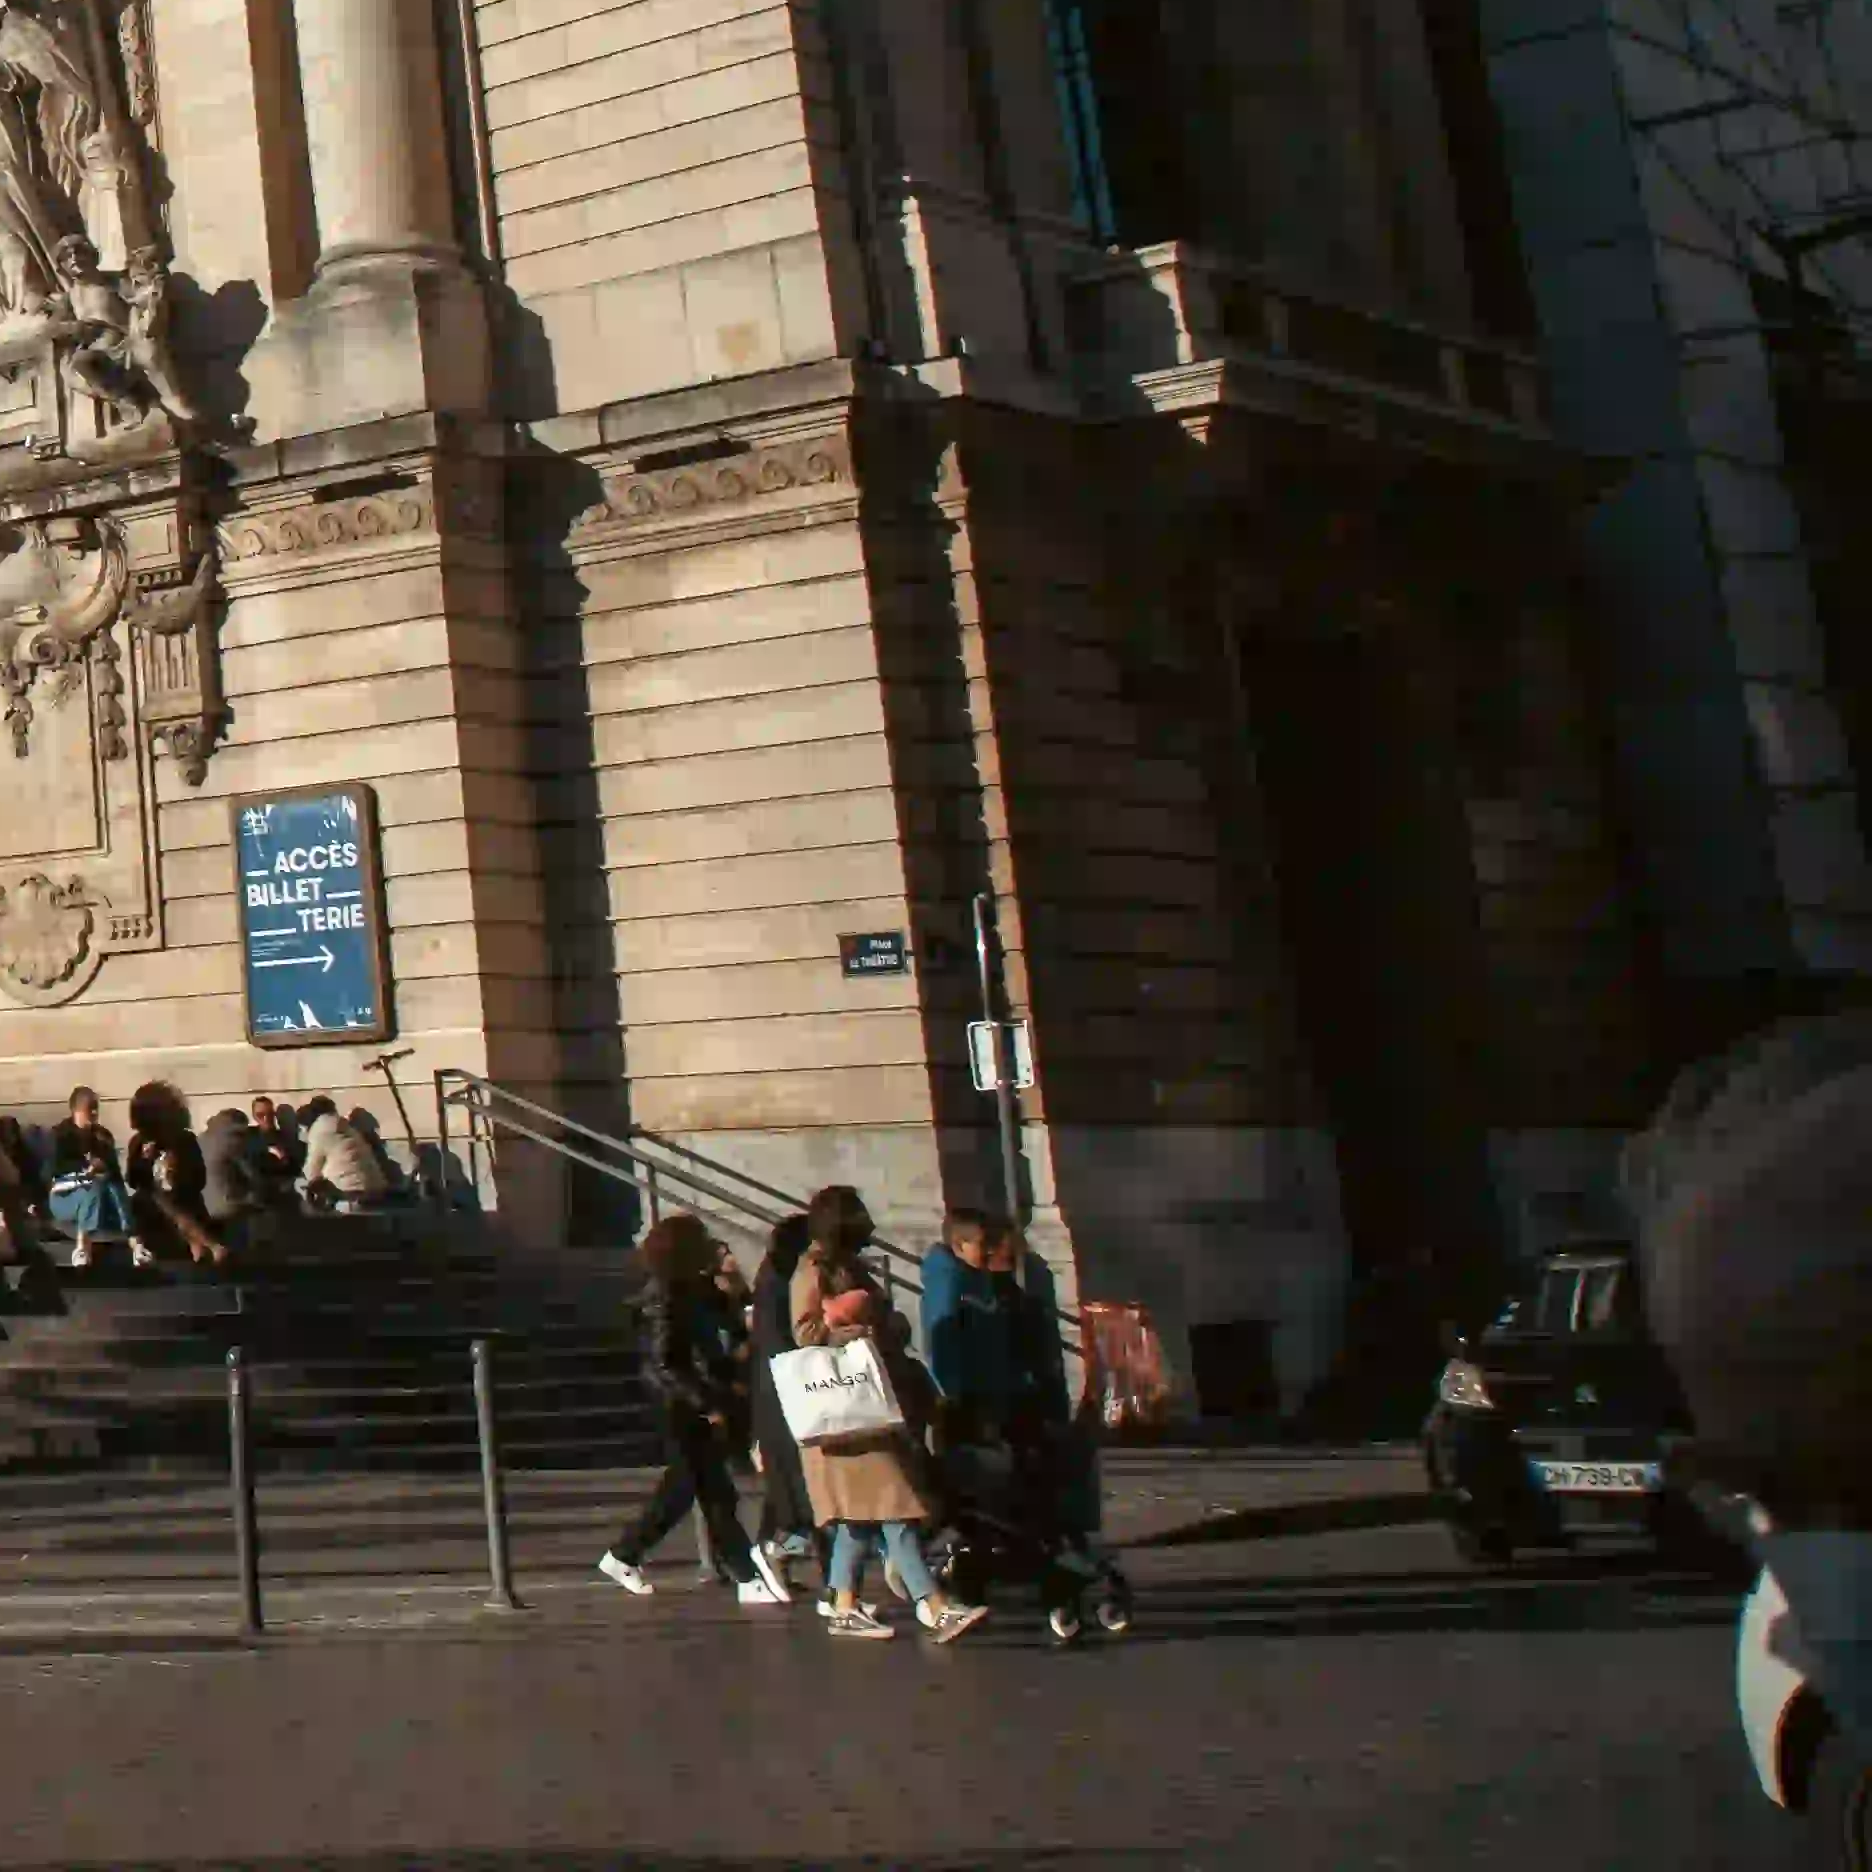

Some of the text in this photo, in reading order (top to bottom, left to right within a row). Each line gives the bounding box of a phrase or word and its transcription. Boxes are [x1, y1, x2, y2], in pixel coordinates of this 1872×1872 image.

[274, 839, 358, 875] ACCÈS
[247, 877, 324, 907] BILLET
[296, 903, 365, 933] TERIE
[804, 1371, 868, 1393] MANGO
